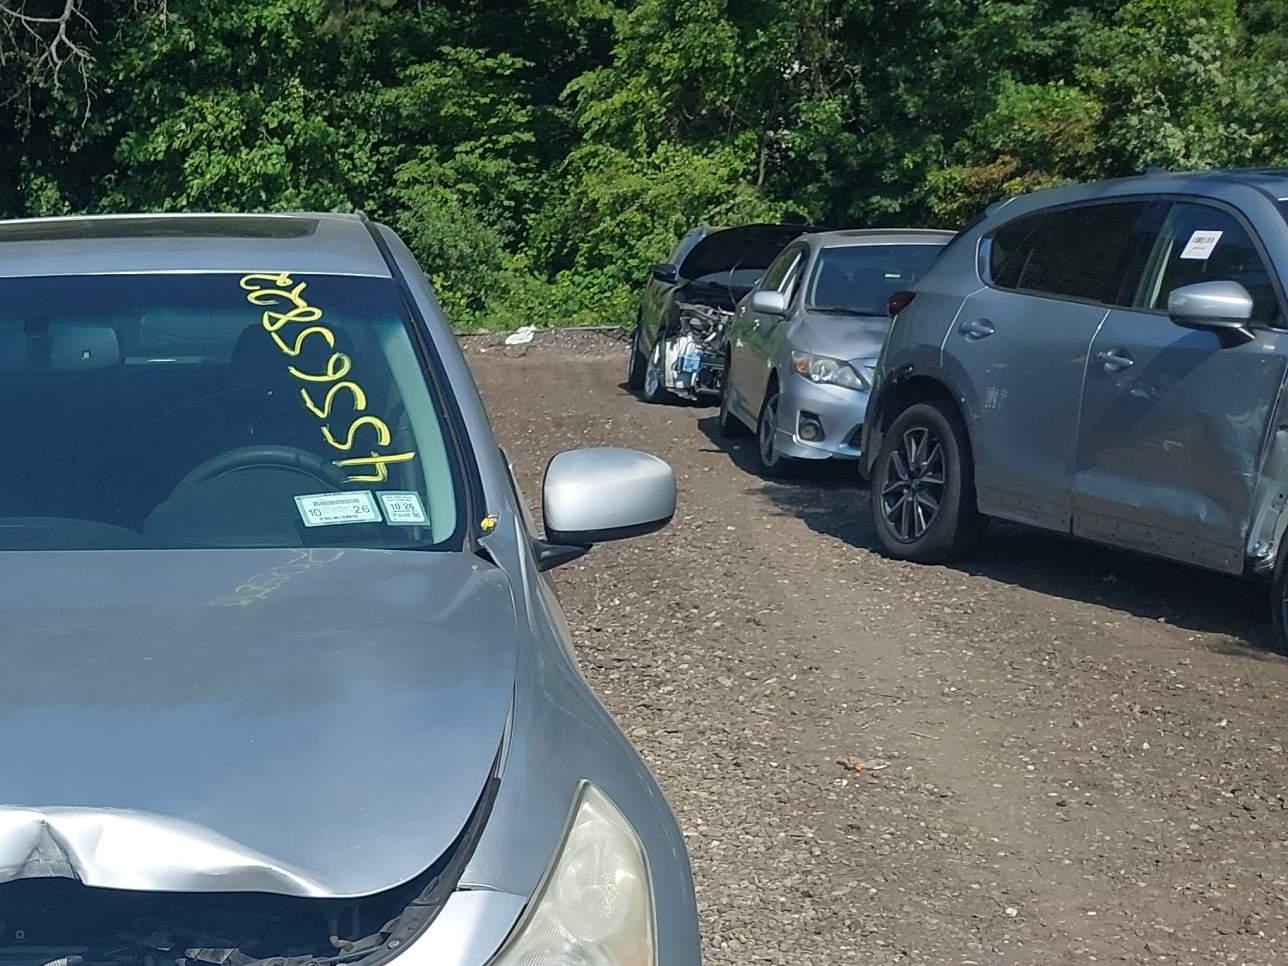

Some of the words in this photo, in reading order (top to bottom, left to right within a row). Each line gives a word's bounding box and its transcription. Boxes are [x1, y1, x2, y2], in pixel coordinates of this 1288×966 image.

[240, 273, 415, 483] 45565822
[309, 508, 322, 517] 10
[352, 504, 371, 514] 26
